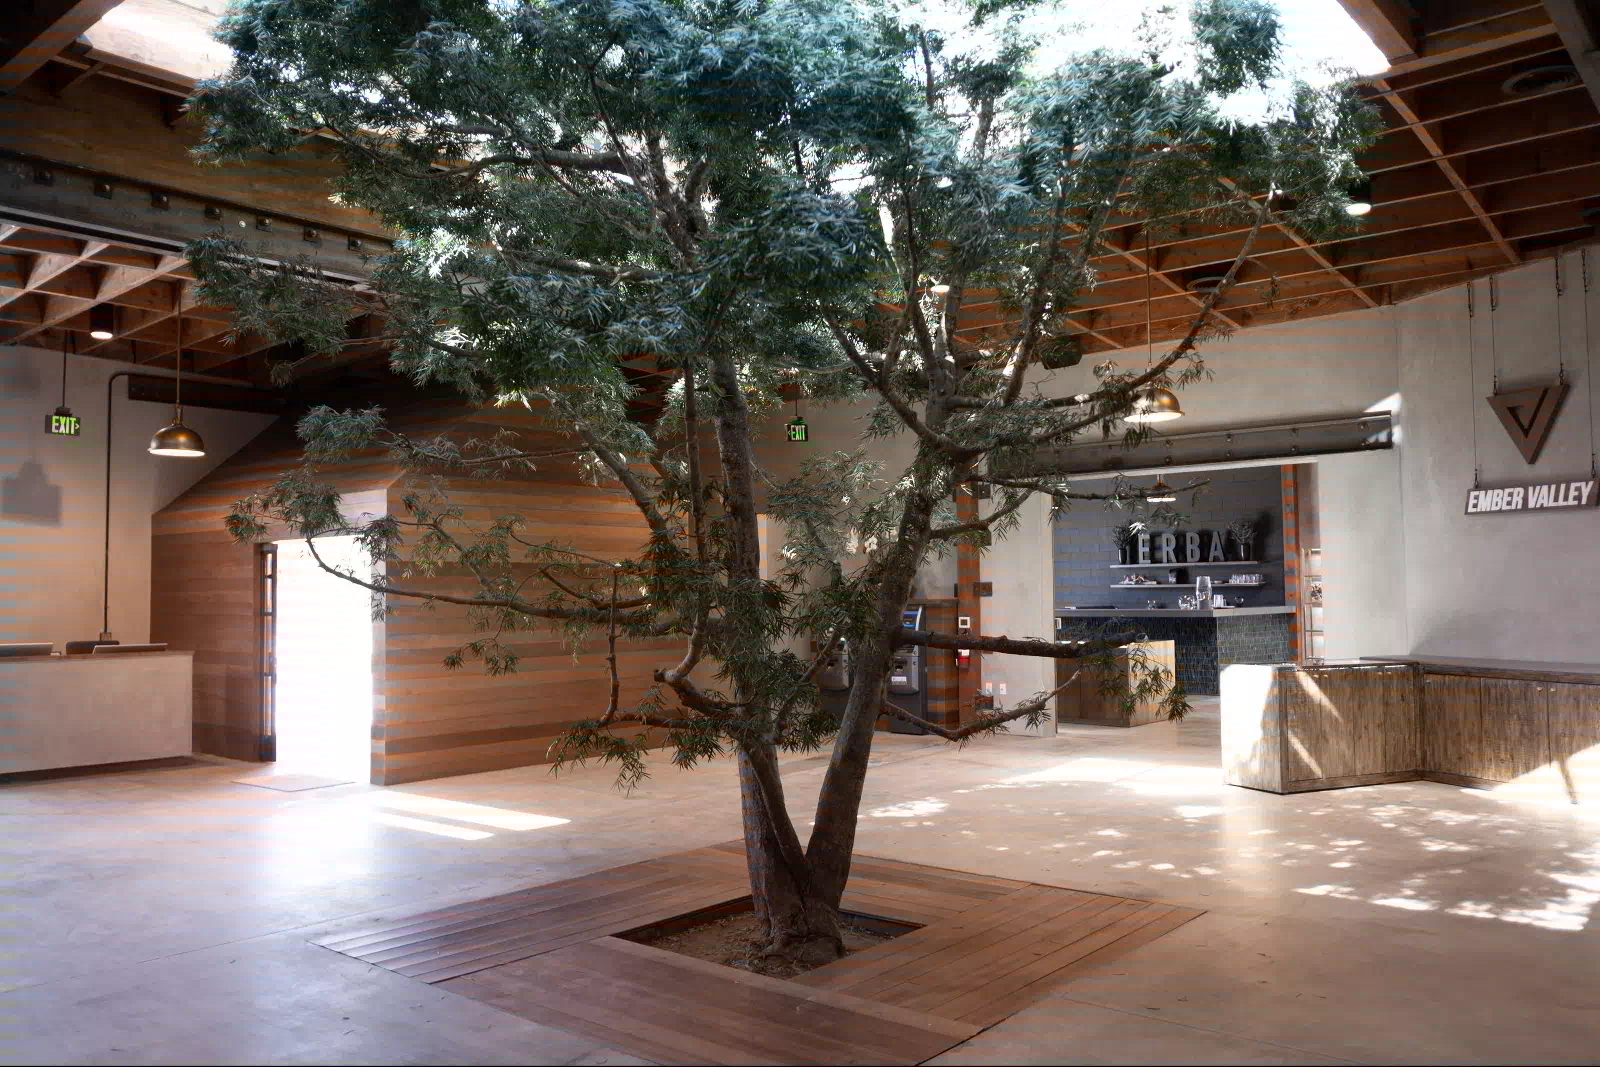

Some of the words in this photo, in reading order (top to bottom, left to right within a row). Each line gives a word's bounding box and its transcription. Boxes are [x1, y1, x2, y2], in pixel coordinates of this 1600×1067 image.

[52, 415, 76, 435] EXIT
[790, 425, 806, 441] EXIT
[1467, 487, 1524, 513] EMBER
[1527, 480, 1594, 508] VALLEY
[1138, 531, 1225, 563] ERBA
